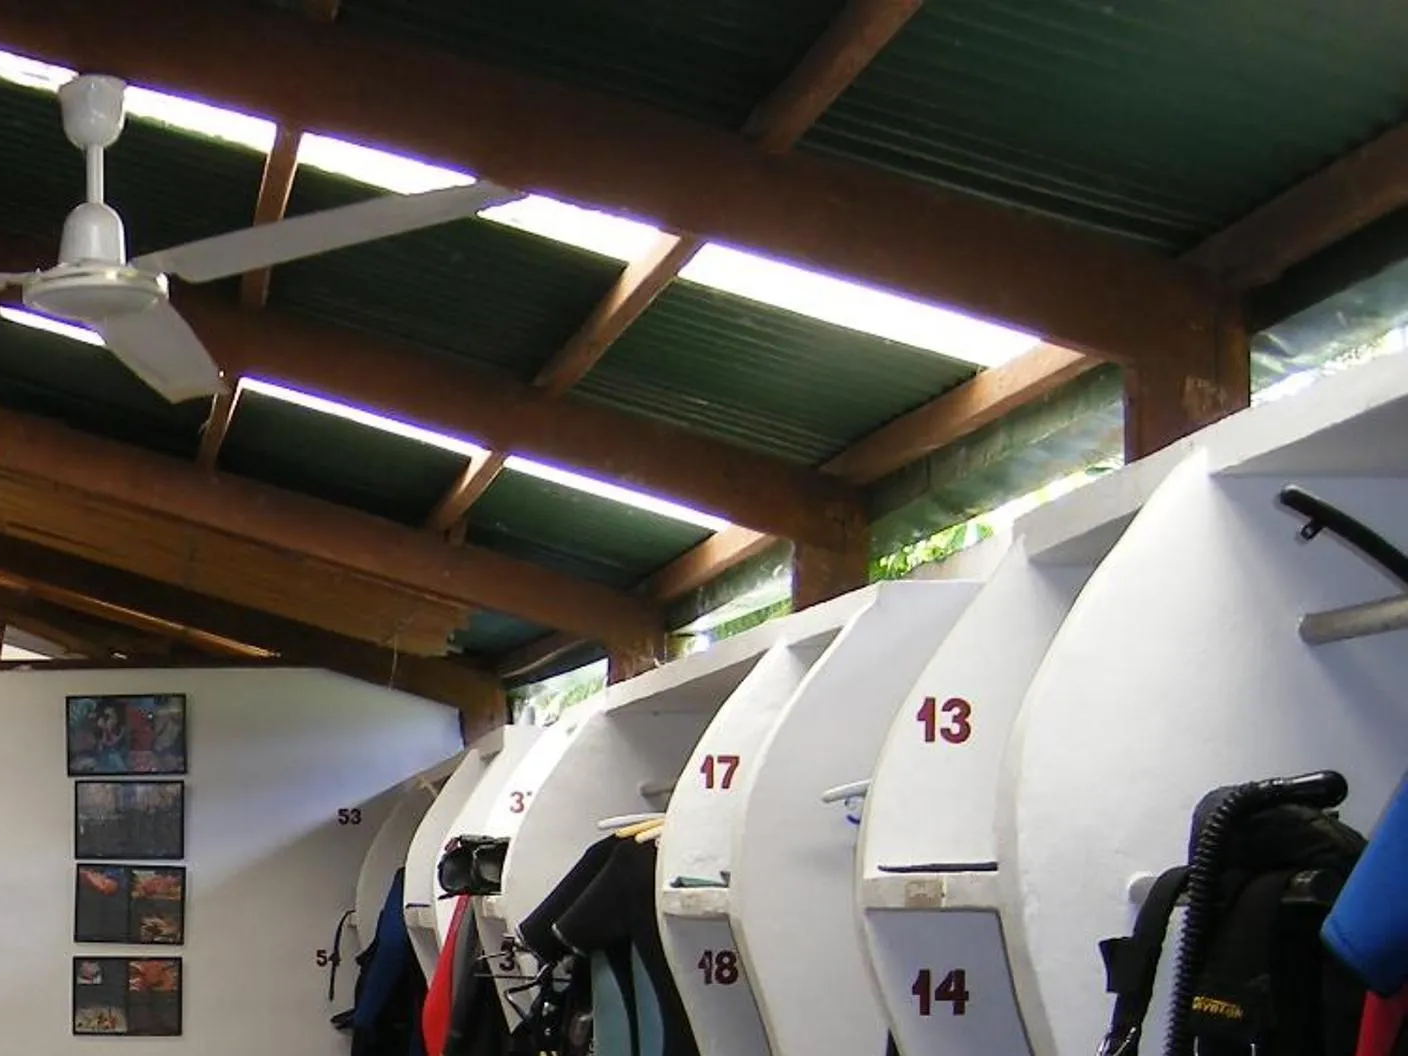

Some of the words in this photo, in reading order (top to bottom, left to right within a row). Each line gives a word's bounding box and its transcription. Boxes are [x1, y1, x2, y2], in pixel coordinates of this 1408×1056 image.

[917, 697, 971, 744] 13
[700, 755, 740, 789] 17
[338, 809, 362, 825] 53
[508, 791, 534, 813] 3
[698, 950, 739, 985] 18
[912, 969, 969, 1015] 14
